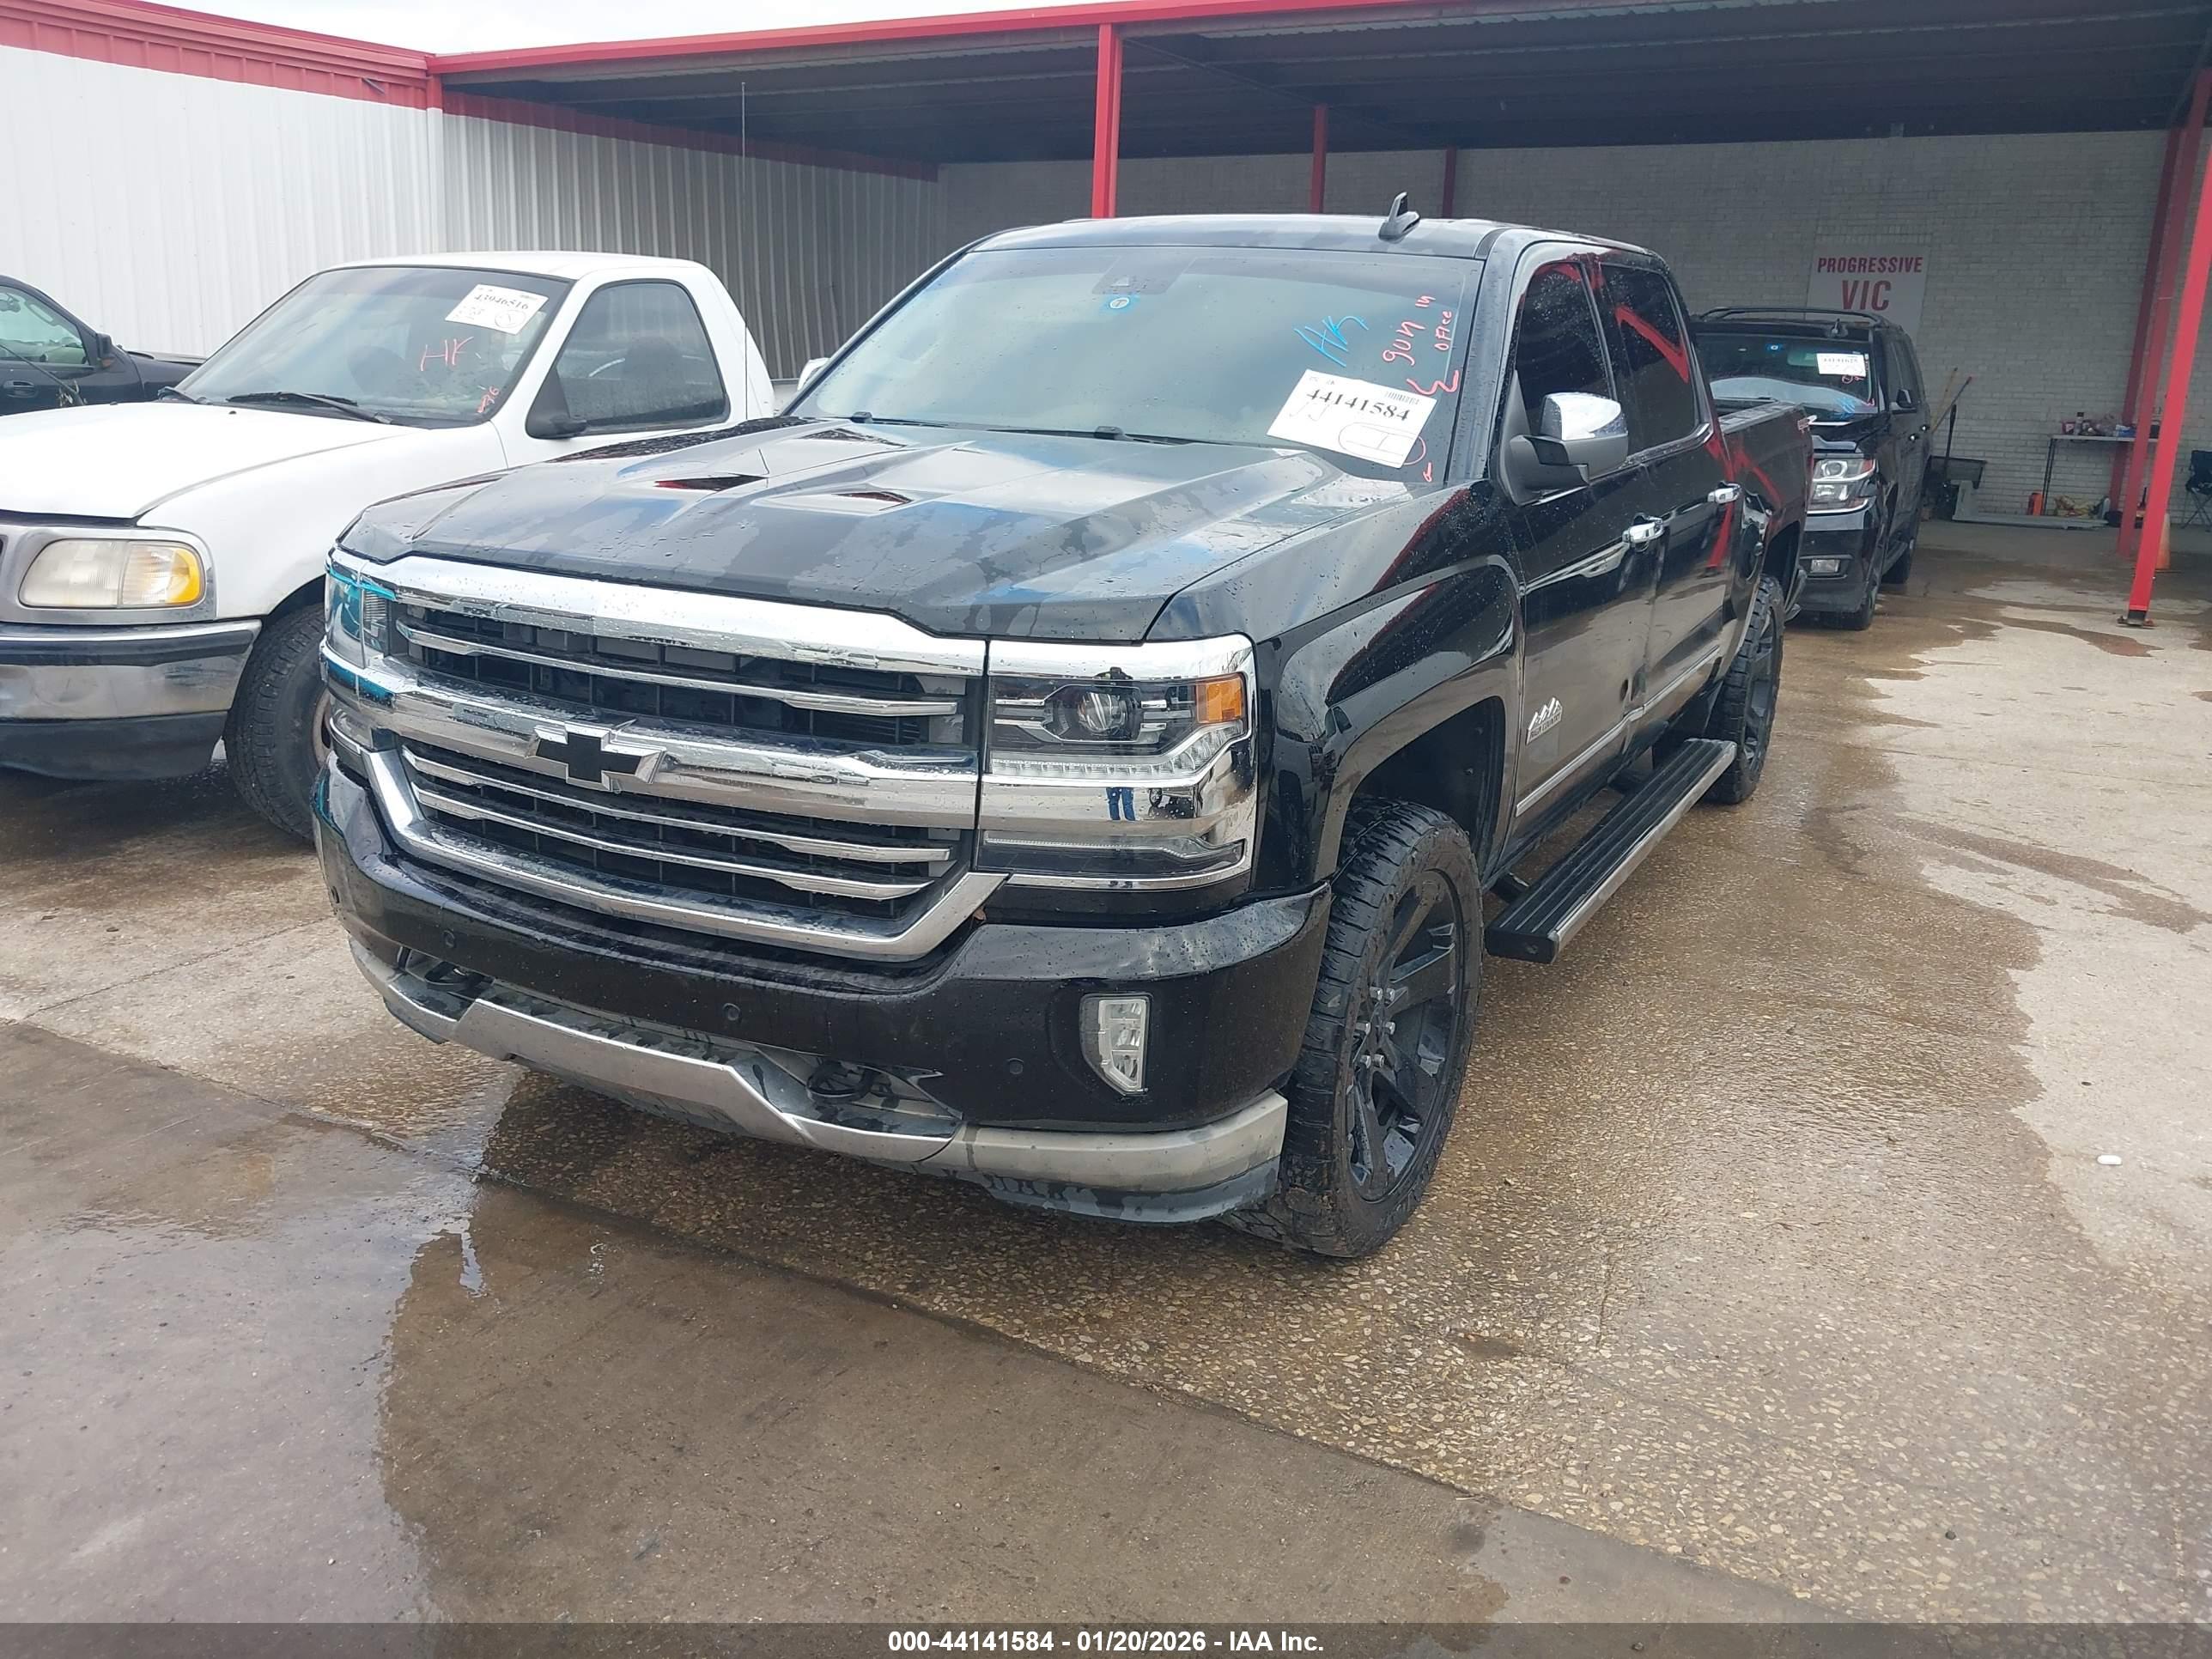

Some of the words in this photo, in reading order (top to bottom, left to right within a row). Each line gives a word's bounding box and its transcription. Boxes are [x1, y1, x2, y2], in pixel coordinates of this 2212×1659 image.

[1817, 257, 1923, 273] PROGRESSIVE
[1842, 280, 1891, 311] VIC
[1306, 389, 1411, 422] 44141584
